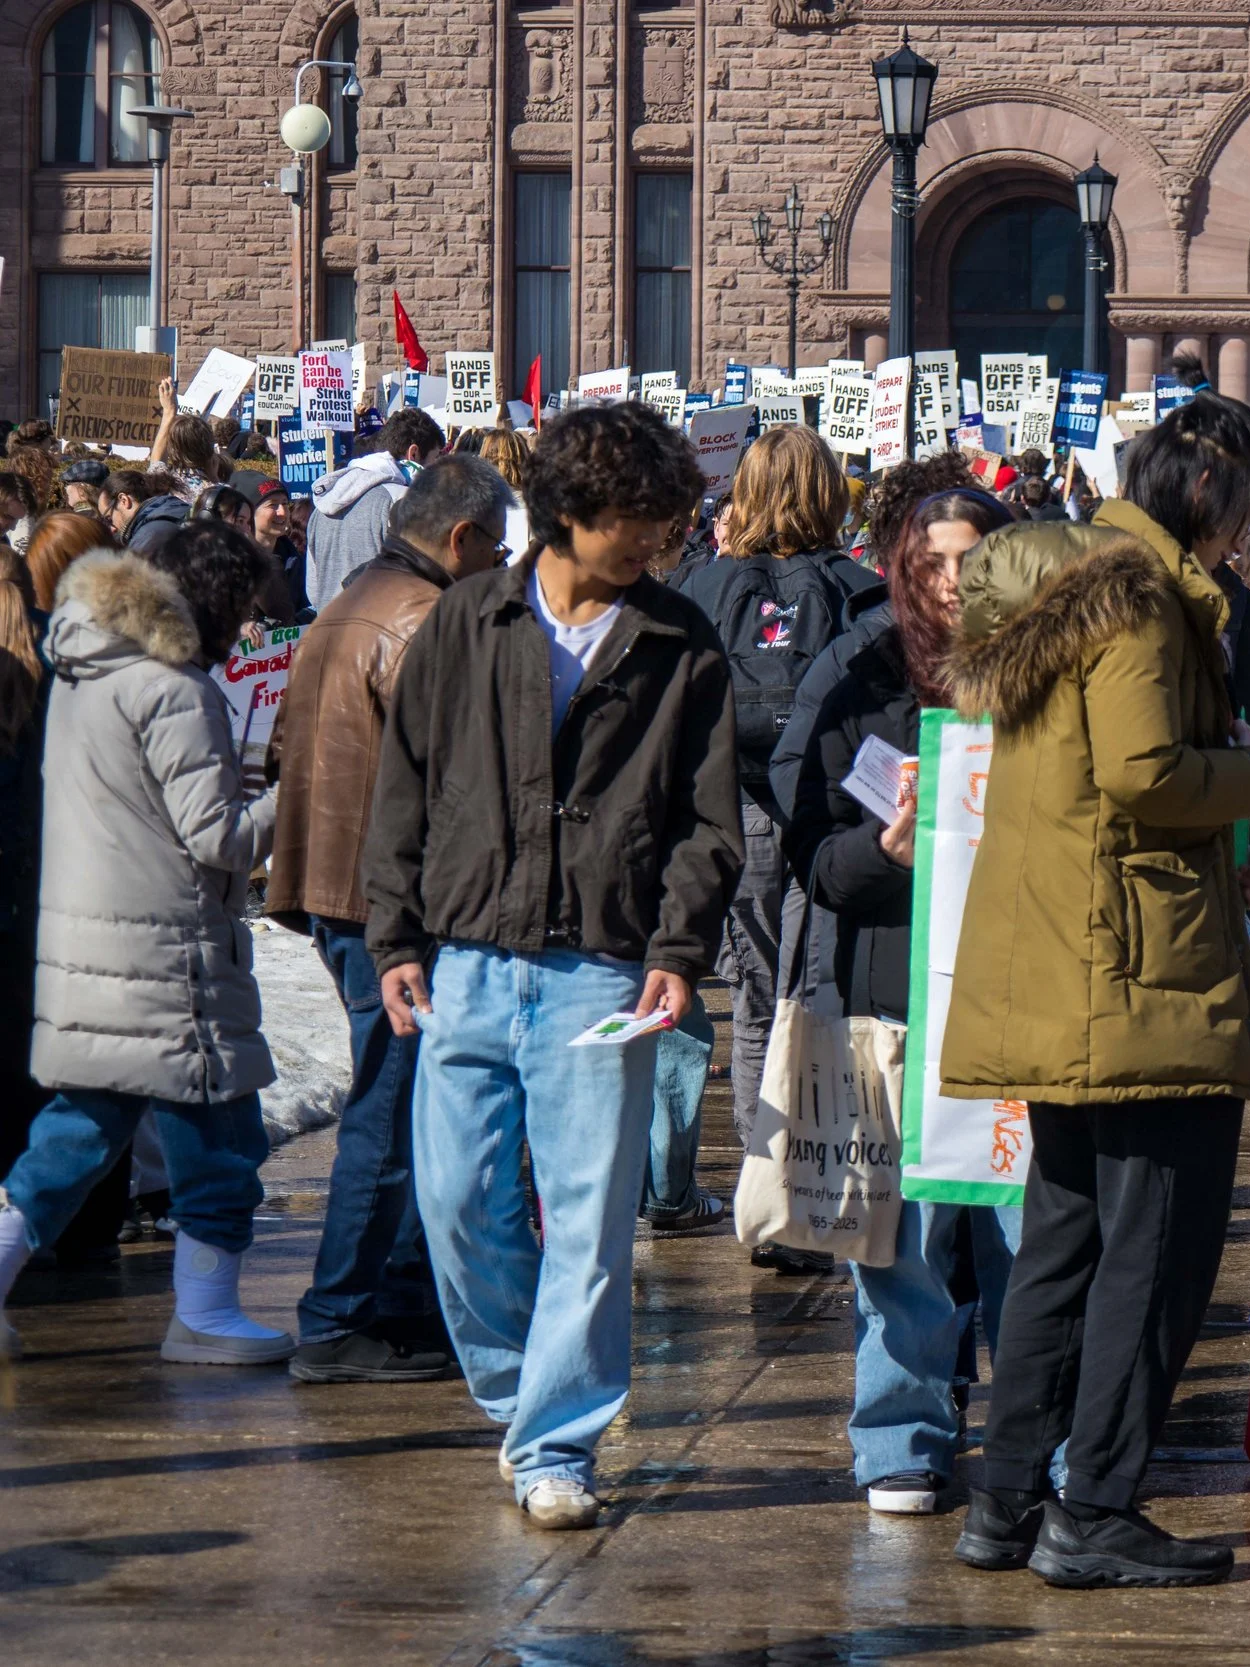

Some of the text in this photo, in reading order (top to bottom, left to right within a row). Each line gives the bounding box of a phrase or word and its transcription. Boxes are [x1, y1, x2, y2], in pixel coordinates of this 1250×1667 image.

[302, 355, 328, 366] Ford
[451, 361, 490, 370] HANDS
[259, 363, 295, 374] HANDS
[303, 366, 341, 377] can be
[915, 363, 949, 374] ANDS
[985, 364, 1024, 373] HANDS
[67, 372, 104, 395] OUR
[259, 374, 295, 393] OFF
[303, 377, 344, 389] beaten
[452, 371, 490, 389] OFF
[645, 378, 672, 389] HANDS
[876, 376, 903, 390] PREPARE
[986, 374, 1024, 390] OFF
[317, 388, 351, 400] Strike
[583, 384, 622, 399] PREPARE
[792, 382, 825, 394] HANDS
[835, 384, 869, 397] HANDS
[1060, 382, 1102, 395] students
[651, 395, 681, 405] HANDS
[884, 393, 890, 402] A
[178, 405, 193, 414] NDS
[258, 402, 294, 410] EDUCATION
[310, 399, 352, 411] Protest
[454, 400, 492, 413] OSAP
[833, 396, 868, 416] OFF
[874, 404, 902, 419] STUDENT
[306, 411, 352, 422] Walkout
[762, 408, 798, 421] ANDS
[841, 416, 855, 424] OUR
[1024, 412, 1051, 421] DROP
[875, 419, 899, 432] STRIKE!
[1023, 421, 1049, 433] FEES
[1055, 412, 1097, 433] UNITED
[115, 420, 160, 441] POCKET
[282, 430, 327, 443] studen
[830, 424, 864, 440] OSAP
[915, 429, 938, 445] AP
[699, 432, 737, 445] BLOCK
[1021, 432, 1047, 444] NOT
[696, 443, 739, 455] VERYTHING!
[285, 450, 327, 466] worker
[283, 464, 327, 483] UNITE
[271, 627, 300, 645] RICH
[771, 640, 791, 648] TOUR
[225, 642, 293, 683] Canad
[254, 681, 286, 710] Firs
[815, 1186, 826, 1203] of
